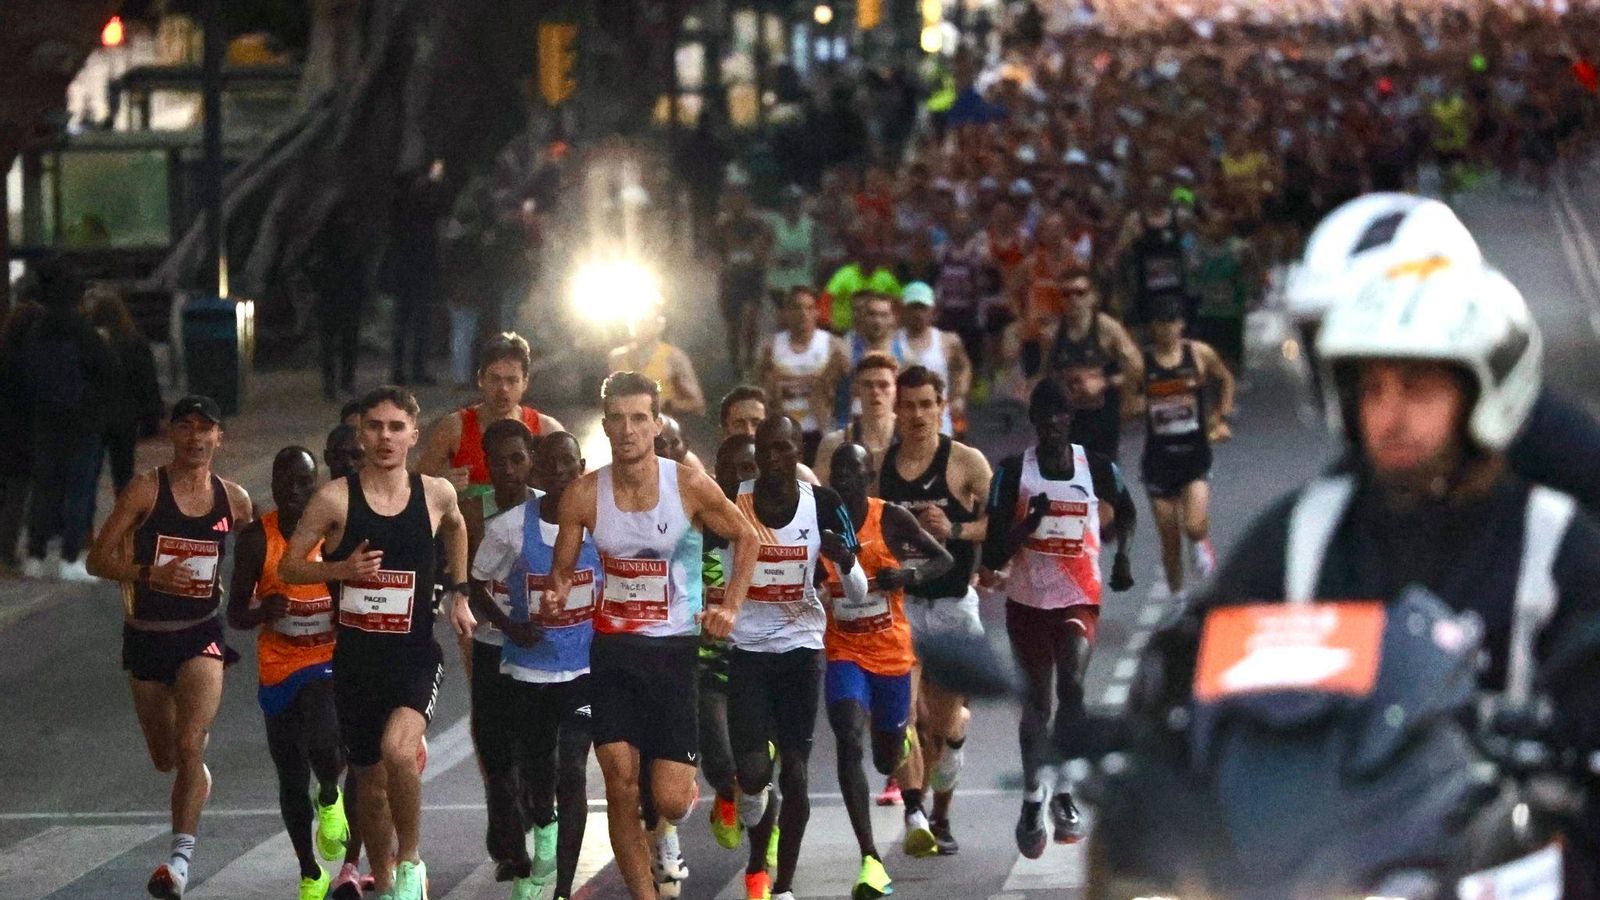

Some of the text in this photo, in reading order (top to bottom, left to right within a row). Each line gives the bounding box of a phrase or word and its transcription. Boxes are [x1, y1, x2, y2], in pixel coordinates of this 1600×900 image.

[761, 546, 804, 557] GENERALI
[616, 561, 662, 572] GENERALI
[764, 568, 785, 576] KIGEN
[620, 582, 647, 591] PACER
[363, 595, 387, 604] PACER
